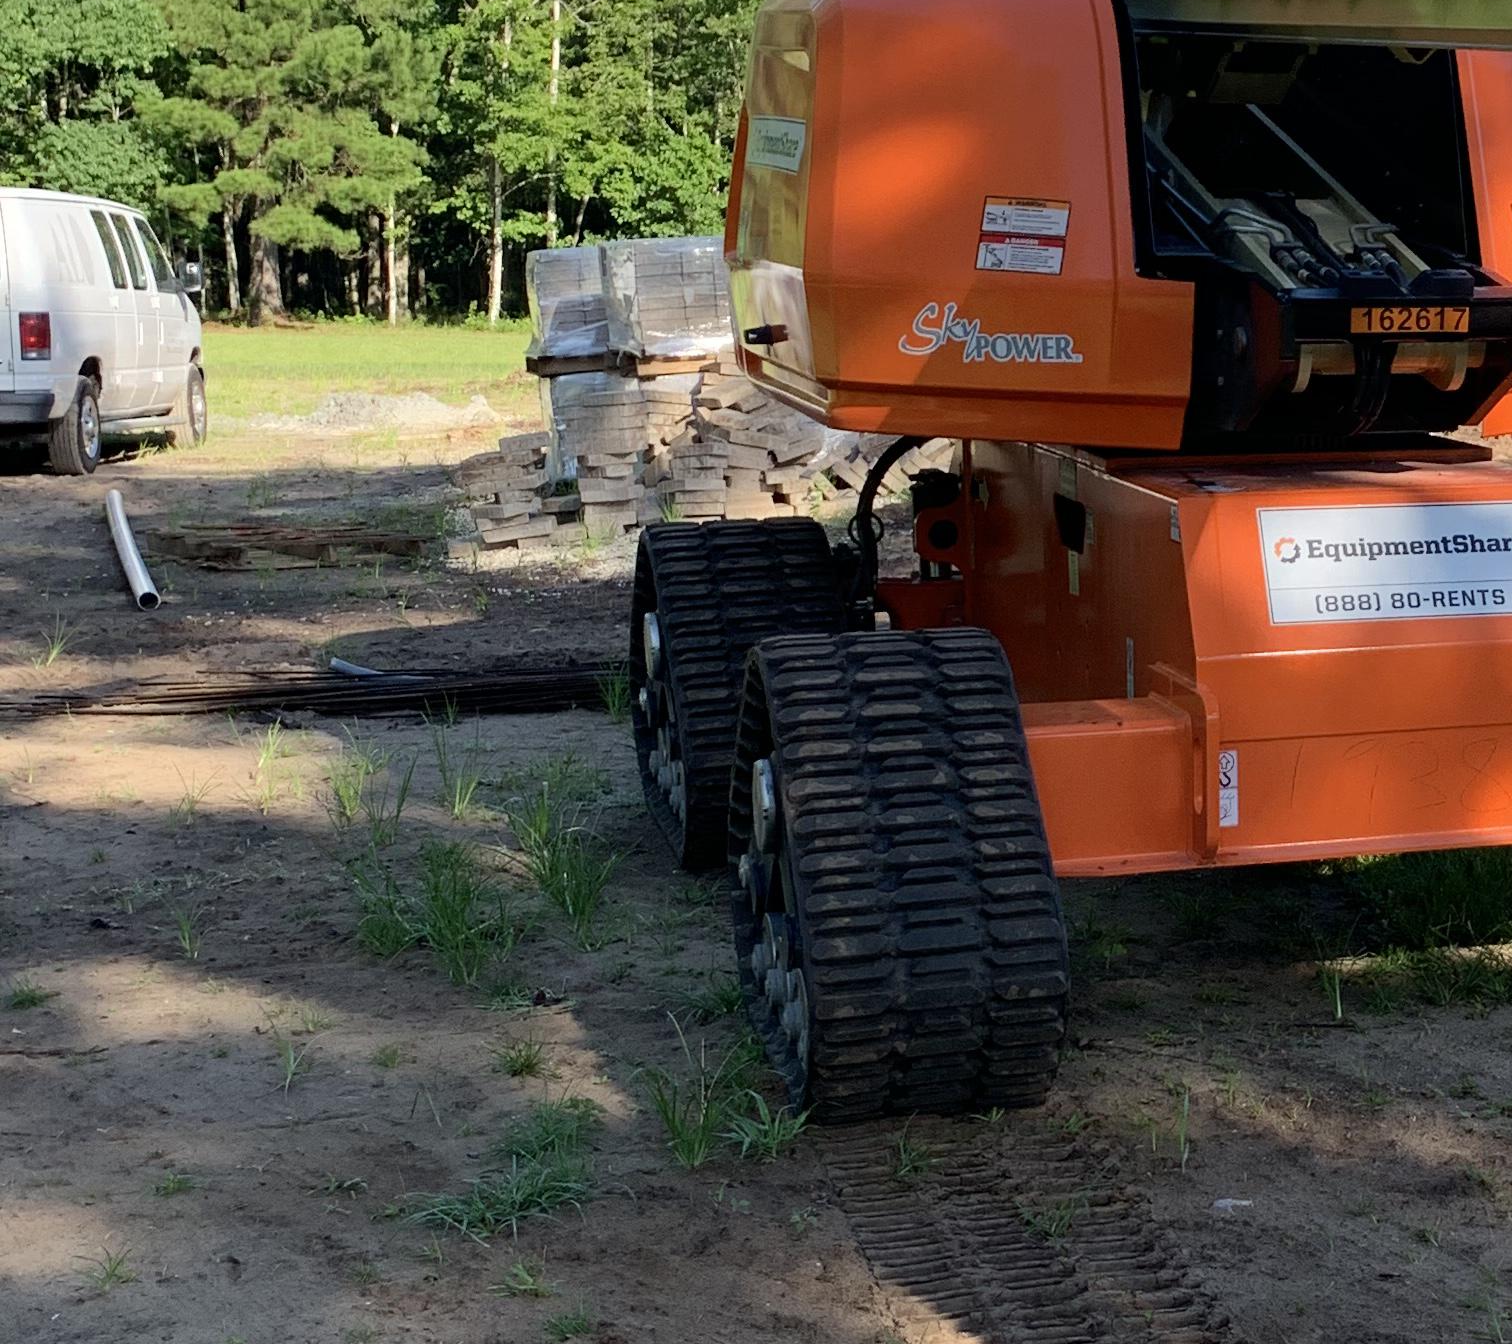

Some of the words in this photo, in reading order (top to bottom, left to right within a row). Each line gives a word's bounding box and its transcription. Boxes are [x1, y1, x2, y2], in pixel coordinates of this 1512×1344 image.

[1362, 308, 1467, 331] 162617
[1316, 592, 1381, 613] (888)
[1390, 588, 1506, 609] 80-RENTS
